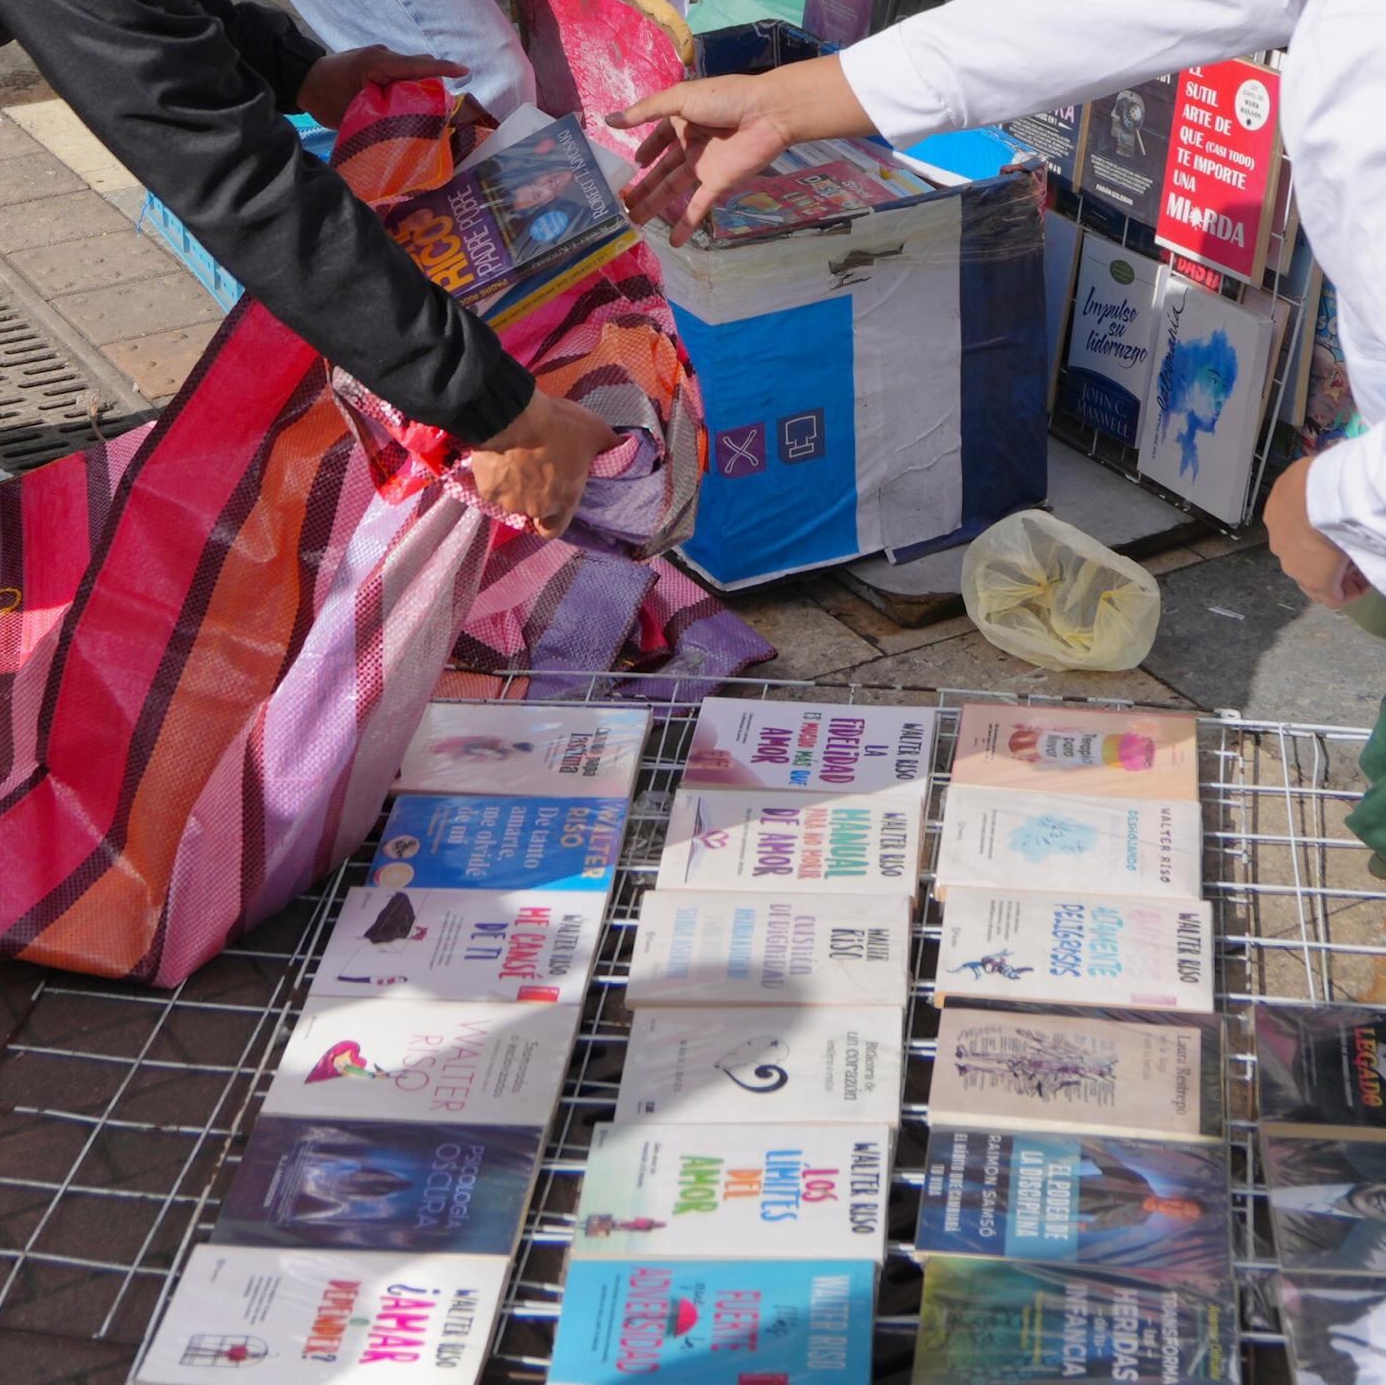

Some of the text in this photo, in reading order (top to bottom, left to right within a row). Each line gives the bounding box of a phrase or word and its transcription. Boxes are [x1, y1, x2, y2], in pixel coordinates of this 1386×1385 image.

[1182, 104, 1232, 136] ARTE DE
[1185, 81, 1219, 108] SUTIL
[1177, 147, 1247, 190] TE IMPORTE
[1179, 126, 1255, 171] QUE (CASI TODO)
[579, 176, 609, 219] ROBERT
[1173, 170, 1197, 193] UNA
[446, 184, 503, 278] PADRE POBRE
[1166, 192, 1245, 248] MIRDA
[1086, 329, 1148, 369] liderazgo
[1107, 321, 1126, 338] su
[1077, 398, 1130, 439] MAXWELL
[1081, 382, 1111, 409] JOHN
[750, 726, 794, 765] AMOR
[788, 711, 823, 787] ES MUCHO MÁS QUE
[864, 744, 890, 758] LA
[895, 722, 926, 781] WALTER RISO
[1061, 736, 1076, 760] para
[1076, 733, 1098, 766] Terapia
[455, 805, 473, 823] de
[465, 806, 501, 879] me olvidé
[497, 806, 528, 862] amarte,
[524, 806, 560, 869] De tanto
[560, 807, 590, 849] RISO
[581, 805, 617, 879] WALTER
[751, 807, 800, 879] DE AMOR
[796, 807, 828, 880] PARA NO MORIR
[824, 808, 871, 880] MANUAL
[879, 812, 907, 878] WALTER RISO
[1126, 809, 1140, 872] DESHOJANDO
[1159, 807, 1172, 885] WALTER RISO
[464, 922, 510, 960] DE TI
[499, 907, 552, 981] ME CANSÉ
[548, 913, 583, 976] WALTER RISO
[865, 927, 891, 963] WALTER
[1049, 903, 1085, 979] PELIGROSOS
[1088, 905, 1124, 979] ALTAMENTE
[1176, 912, 1201, 985] WALTER RISO
[393, 1033, 443, 1094] RISO
[430, 1018, 493, 1113] WALTER
[843, 1031, 861, 1101] un corazón
[1170, 1034, 1192, 1115] Laura Restrepo
[1354, 1026, 1383, 1108] LEGADO
[413, 1143, 462, 1231] OSCURA
[444, 1144, 486, 1230] PSICOLOGÍA
[672, 1155, 725, 1216] AMOR
[723, 1168, 763, 1201] DEL
[759, 1149, 810, 1222] LÍMITES
[801, 1167, 840, 1203] LOS
[849, 1142, 880, 1235] WALTER RISO
[979, 1134, 1002, 1239] RAIMON SAMSÓ
[1015, 1150, 1044, 1238] LA DISCIPLINA
[1043, 1181, 1071, 1240] PODER DE
[301, 1279, 363, 1364] DEPENDER?
[435, 1287, 479, 1370] WALTER RISO
[616, 1266, 673, 1375] ADVERSIDAD
[710, 1289, 762, 1352] FUERTE
[807, 1274, 851, 1370] WALTER RISO
[1062, 1285, 1088, 1378] INFANCIA
[1112, 1288, 1140, 1383] HERIDAS
[1161, 1291, 1180, 1385] TRANSFORMA
